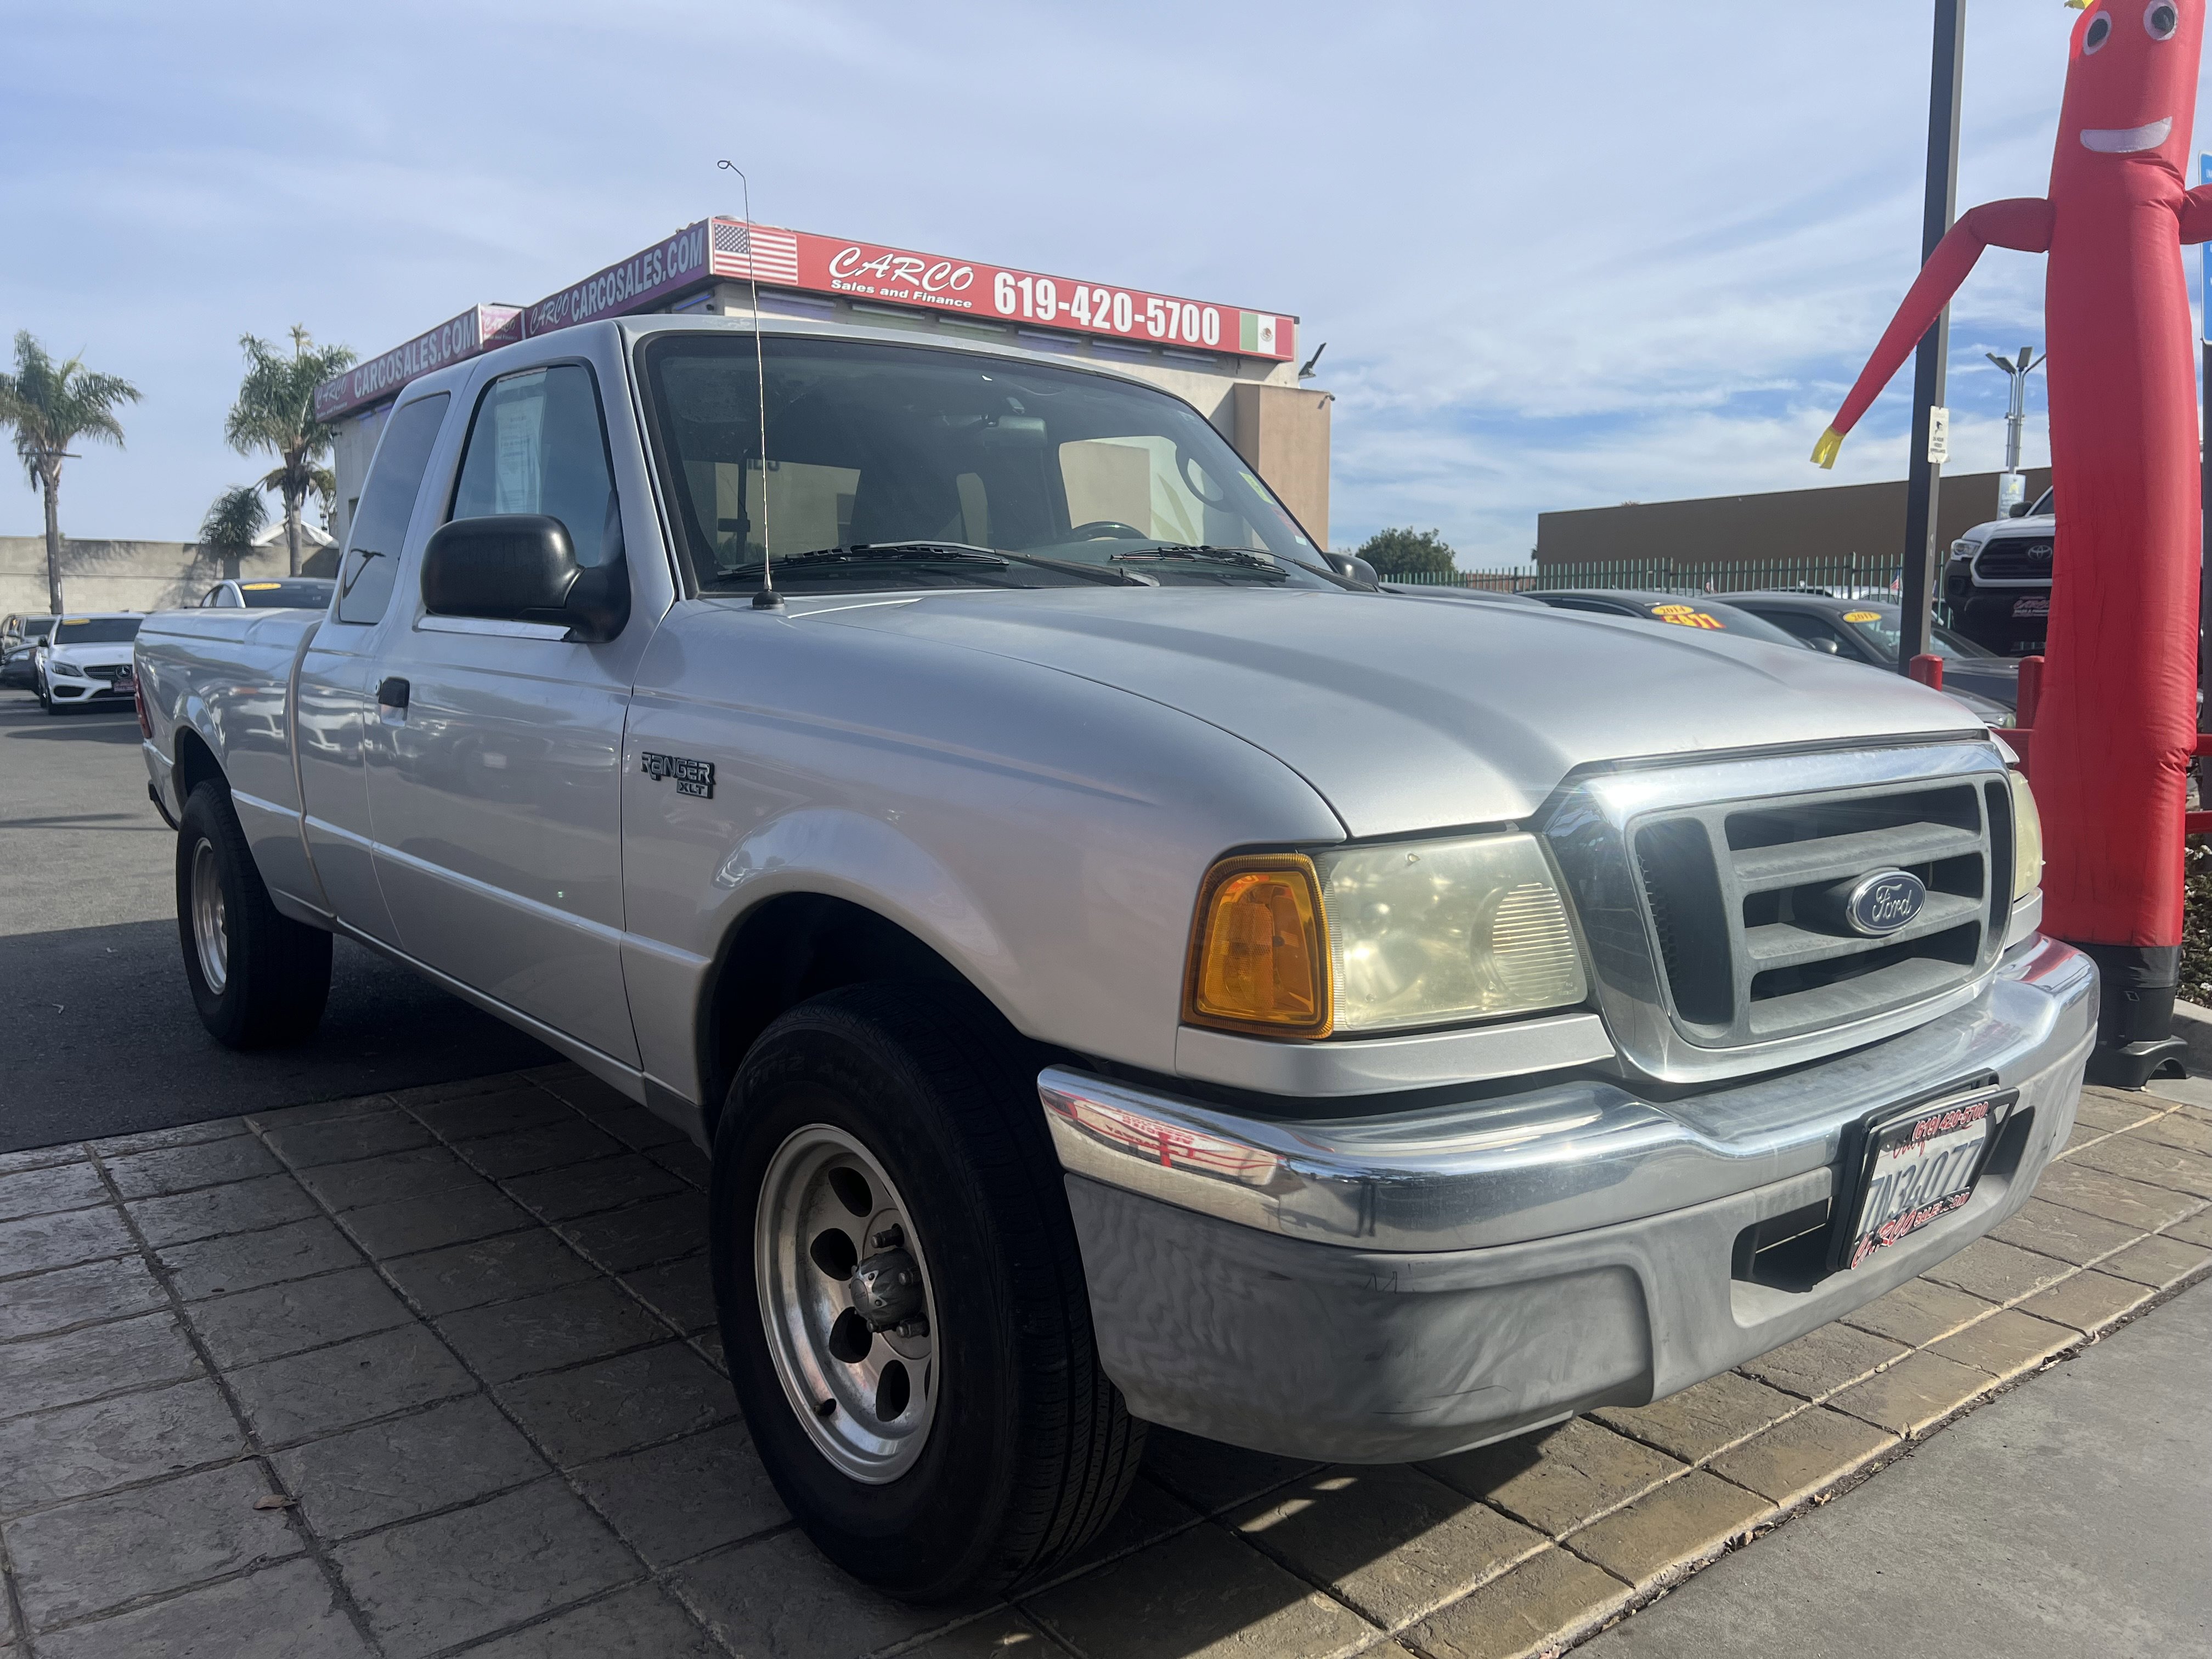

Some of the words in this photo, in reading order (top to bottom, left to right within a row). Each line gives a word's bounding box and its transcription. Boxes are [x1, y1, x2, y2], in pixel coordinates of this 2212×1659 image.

[529, 292, 569, 335] CARCO
[571, 227, 704, 323] CARCOSALES.COM
[828, 246, 974, 292] CARCO
[831, 279, 876, 294] Sales
[879, 287, 909, 298] and
[912, 291, 973, 308] Finance
[994, 272, 1220, 346] 619-420-5700
[354, 312, 475, 399] CARCOSALES.COM
[678, 781, 708, 797] XLT
[1872, 883, 1912, 922] Ford
[1911, 1114, 1941, 1142] (619)
[1939, 1101, 1989, 1131] 420-5700
